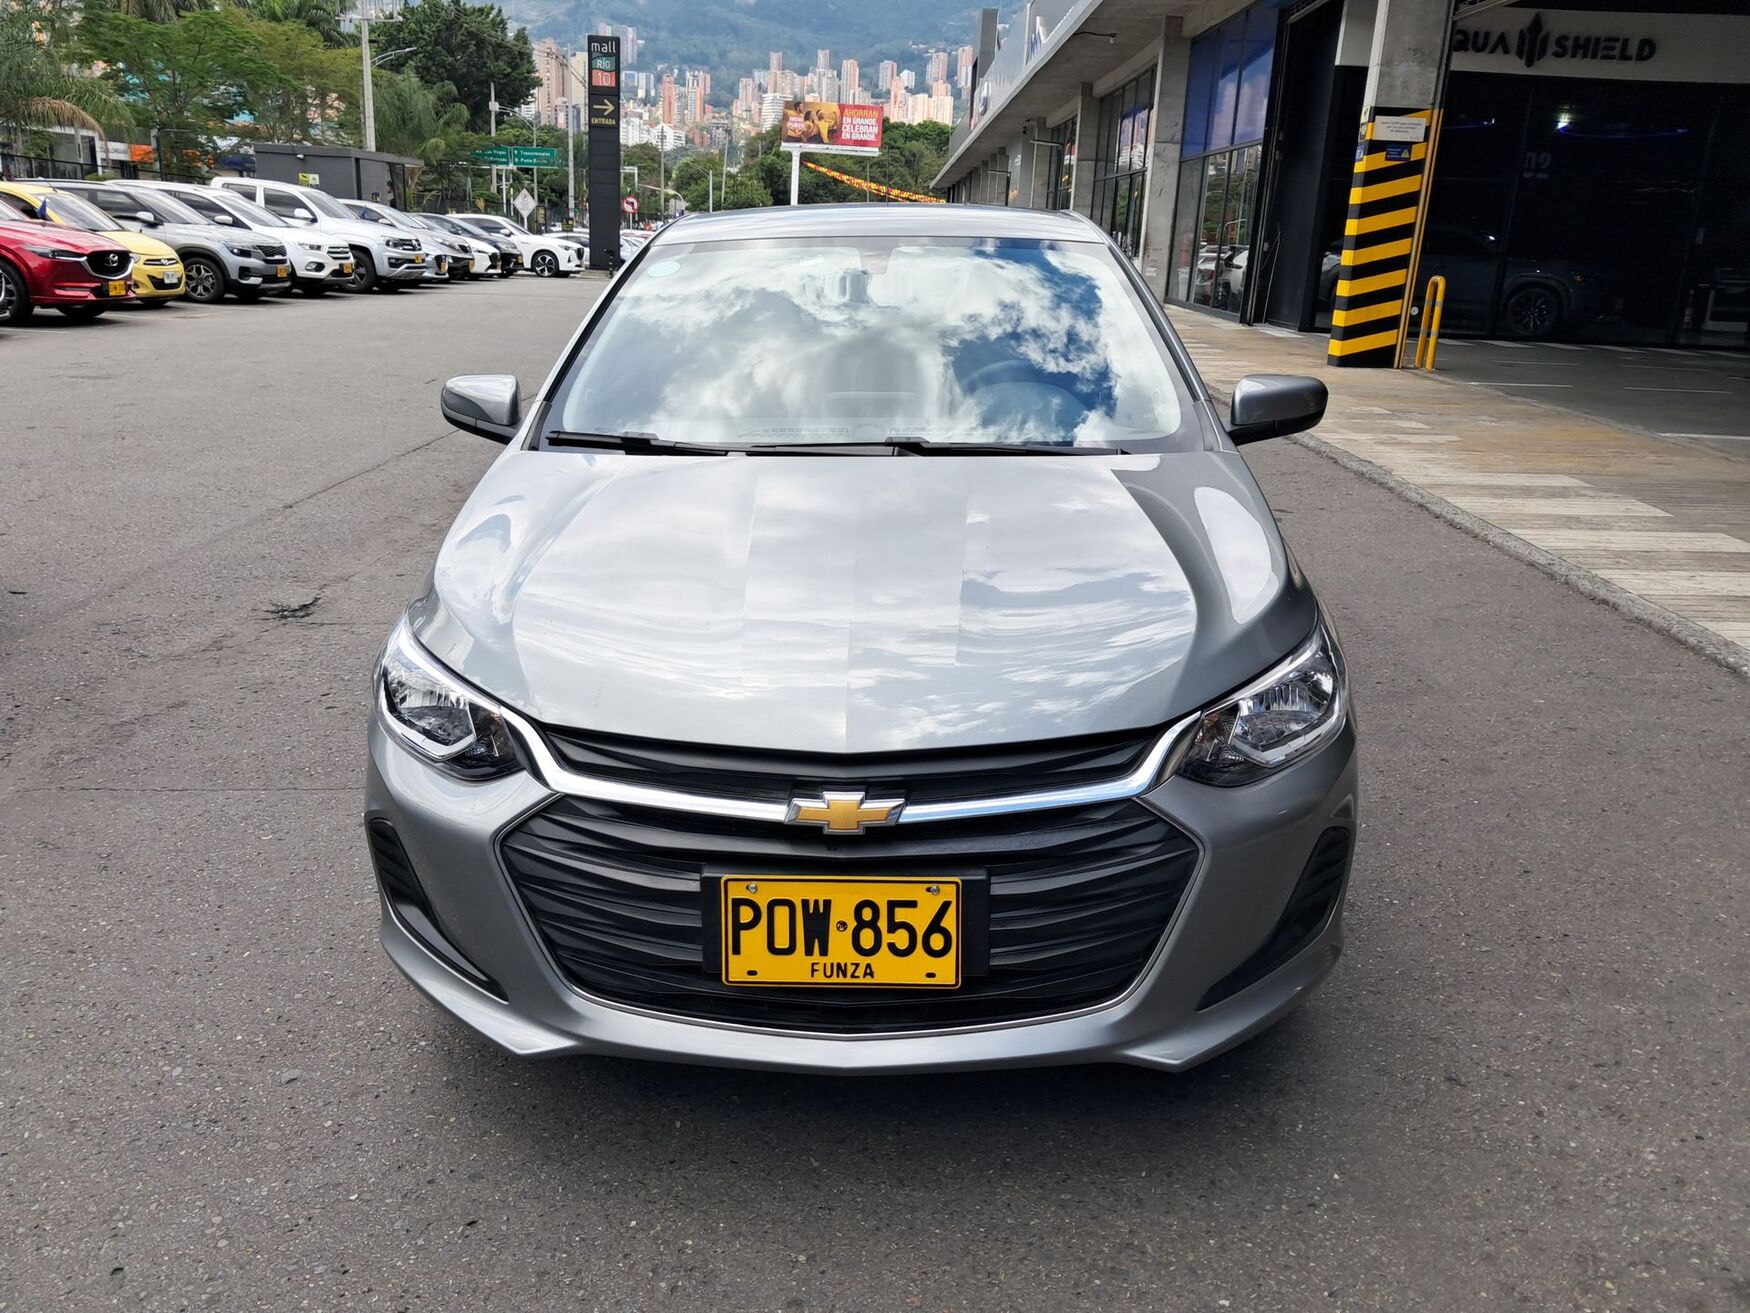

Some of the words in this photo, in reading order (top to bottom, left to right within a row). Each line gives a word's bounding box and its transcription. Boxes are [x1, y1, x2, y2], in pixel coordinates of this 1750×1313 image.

[591, 41, 616, 53] mall
[1552, 34, 1657, 61] SHIELD
[598, 72, 611, 86] 10
[844, 109, 878, 118] AHORRAN
[591, 117, 616, 125] ENTRADA
[843, 116, 851, 124] EN
[842, 124, 878, 134] CELEBRAN
[842, 131, 850, 139] EN
[809, 962, 875, 979] FUNZA
